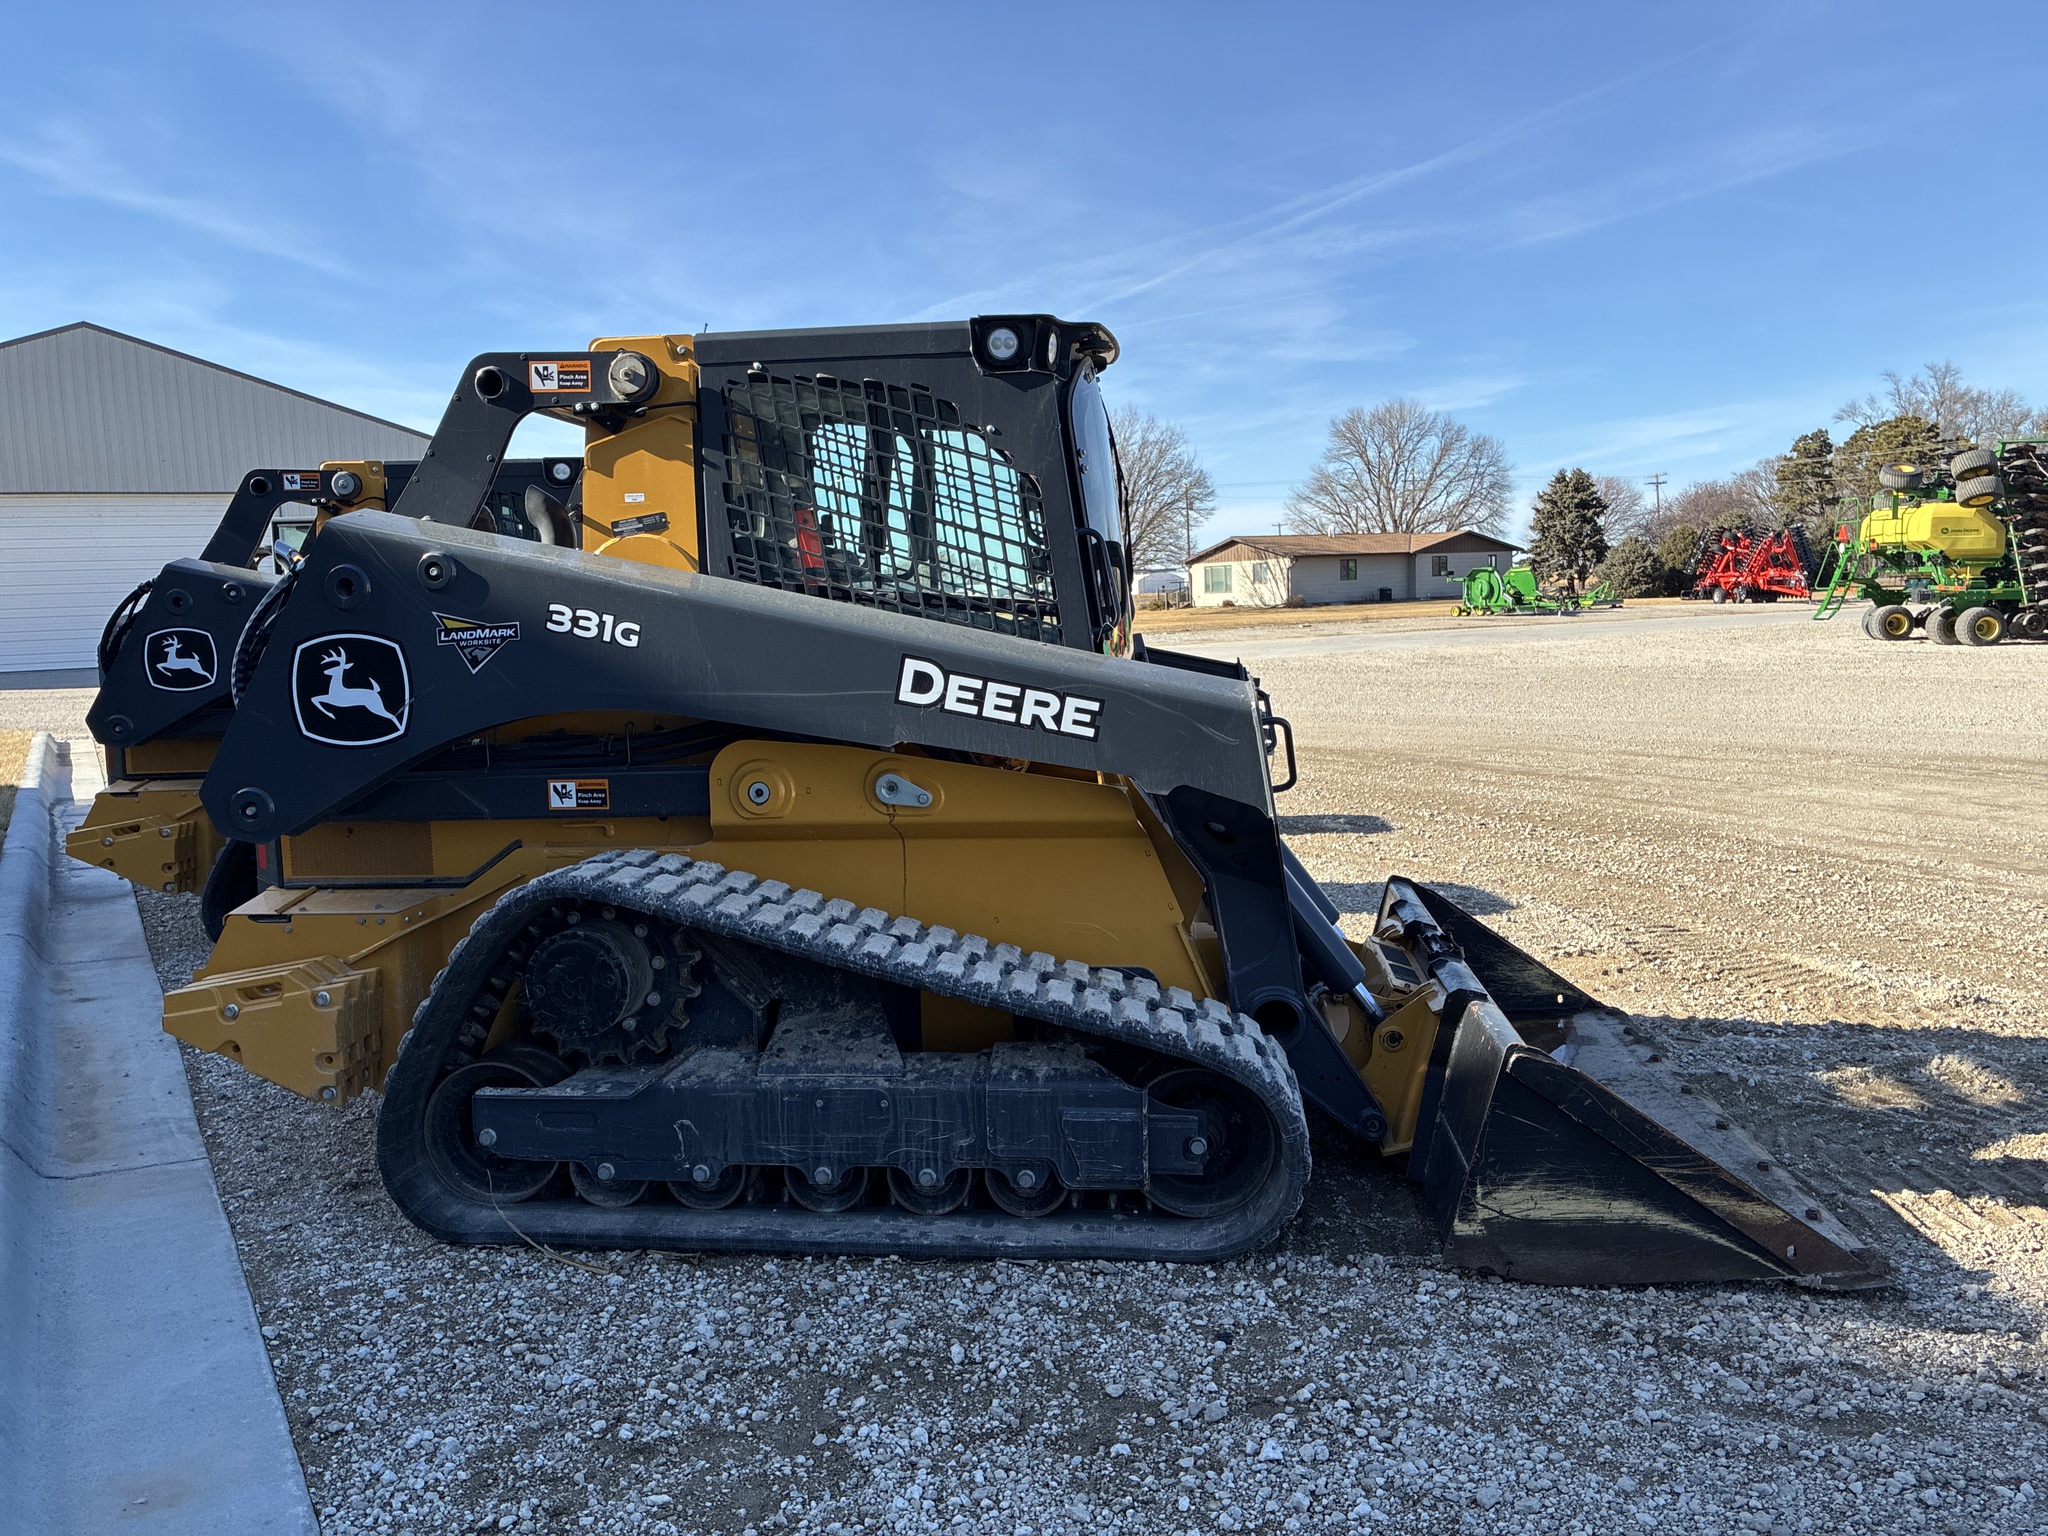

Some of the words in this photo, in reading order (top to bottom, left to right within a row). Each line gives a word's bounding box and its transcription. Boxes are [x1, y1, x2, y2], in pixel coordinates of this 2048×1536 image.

[440, 627, 516, 641] LANDMARK
[545, 603, 641, 648] 331G
[459, 637, 502, 647] WORKSITE
[898, 657, 1100, 738] DEERE
